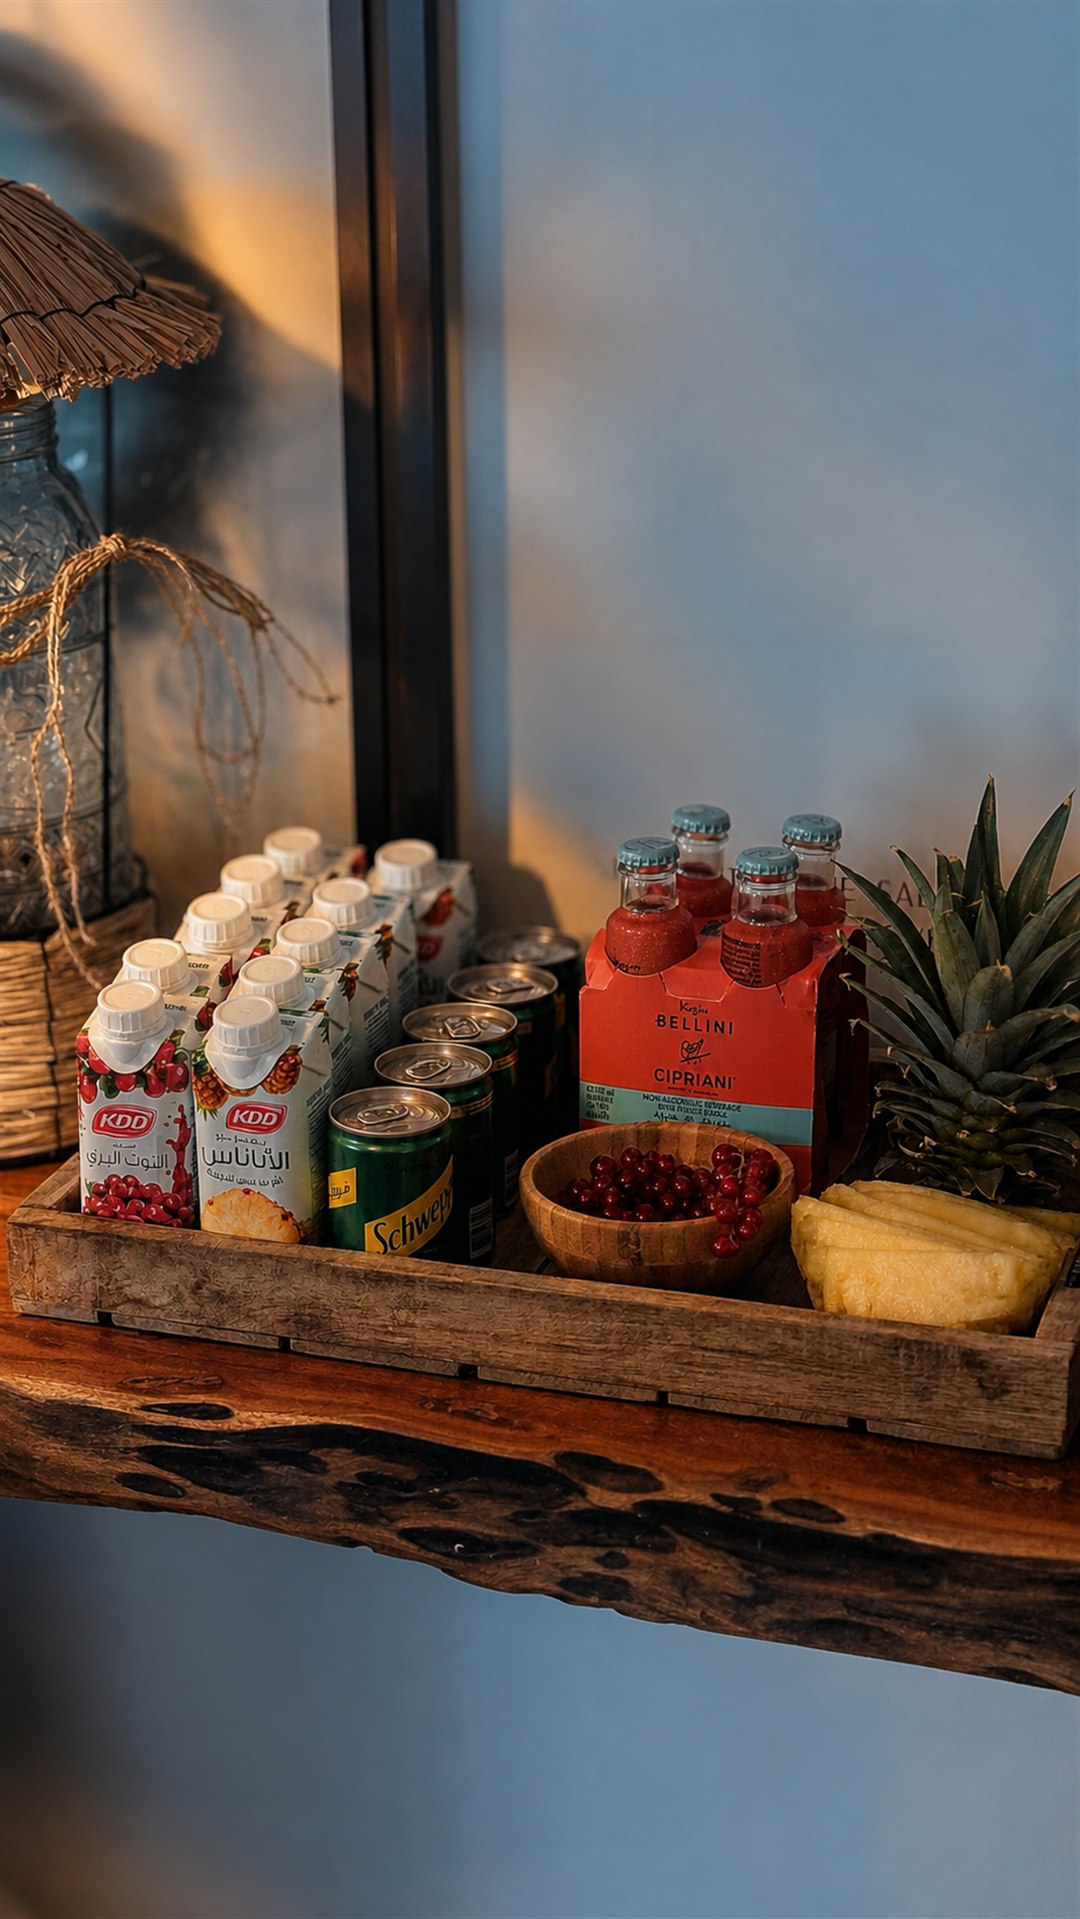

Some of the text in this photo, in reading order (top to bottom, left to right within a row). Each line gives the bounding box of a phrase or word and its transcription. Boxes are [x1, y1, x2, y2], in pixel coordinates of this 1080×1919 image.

[656, 1014, 733, 1035] BELLINI
[654, 1068, 732, 1090] CIPRIANI
[100, 1113, 149, 1129] KDD
[232, 1109, 278, 1126] KDD
